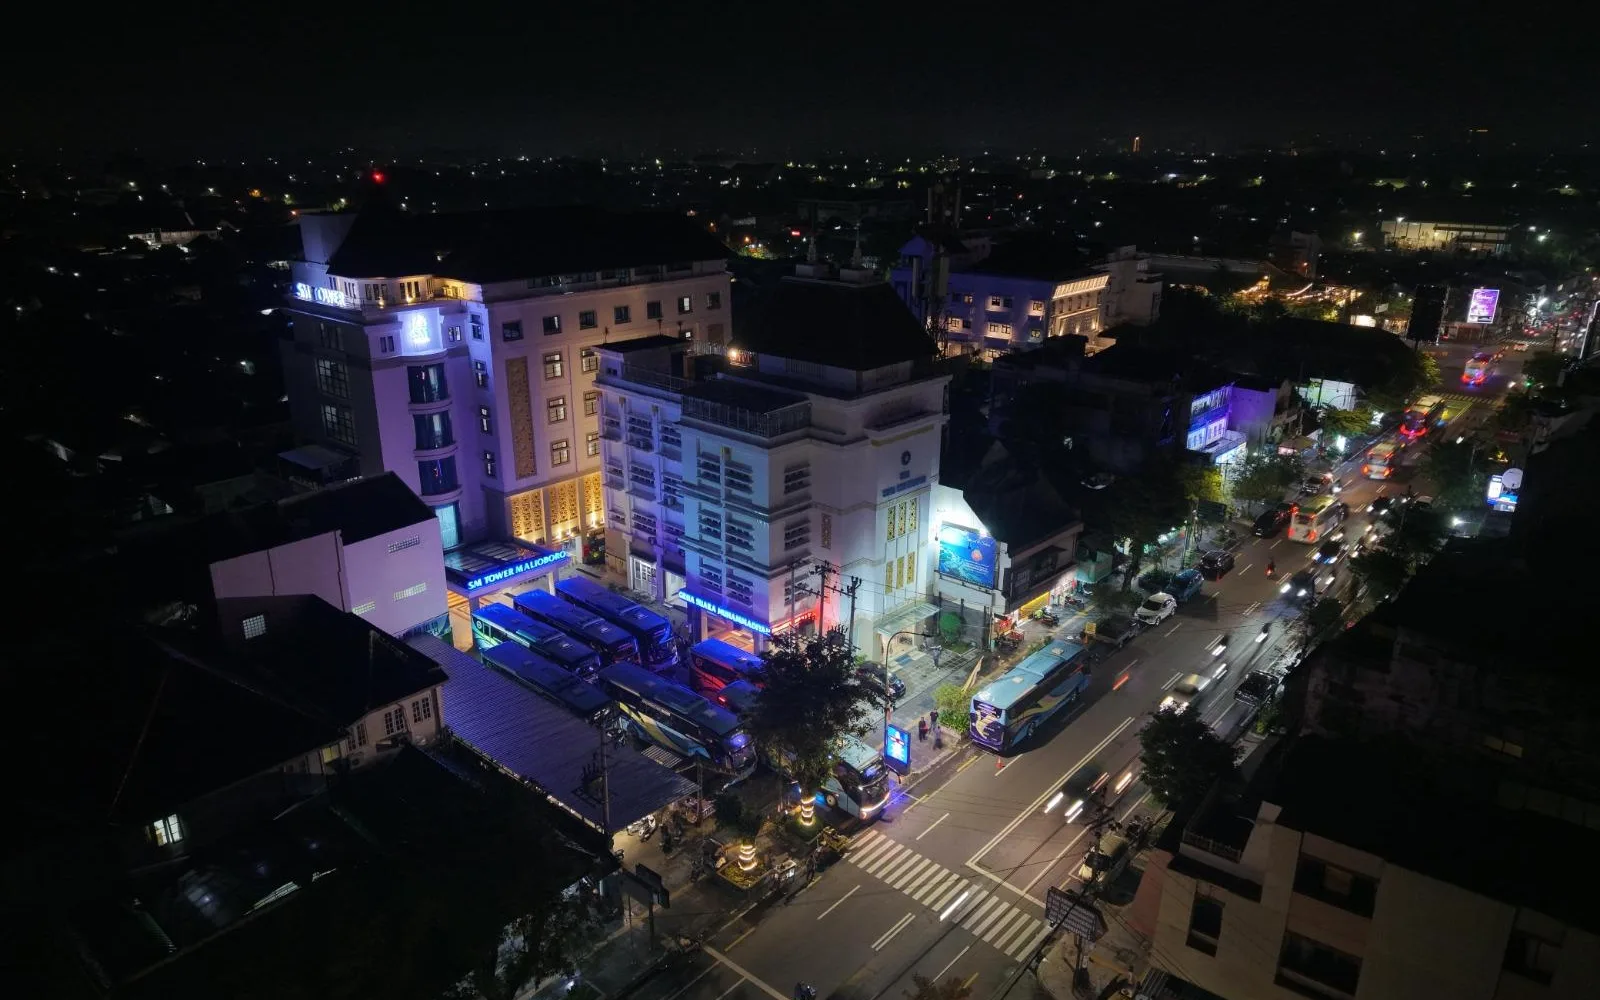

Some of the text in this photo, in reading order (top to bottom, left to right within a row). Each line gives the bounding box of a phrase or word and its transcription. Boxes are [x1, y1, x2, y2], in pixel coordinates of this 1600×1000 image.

[468, 550, 566, 590] SM TOWER MALIOBORO
